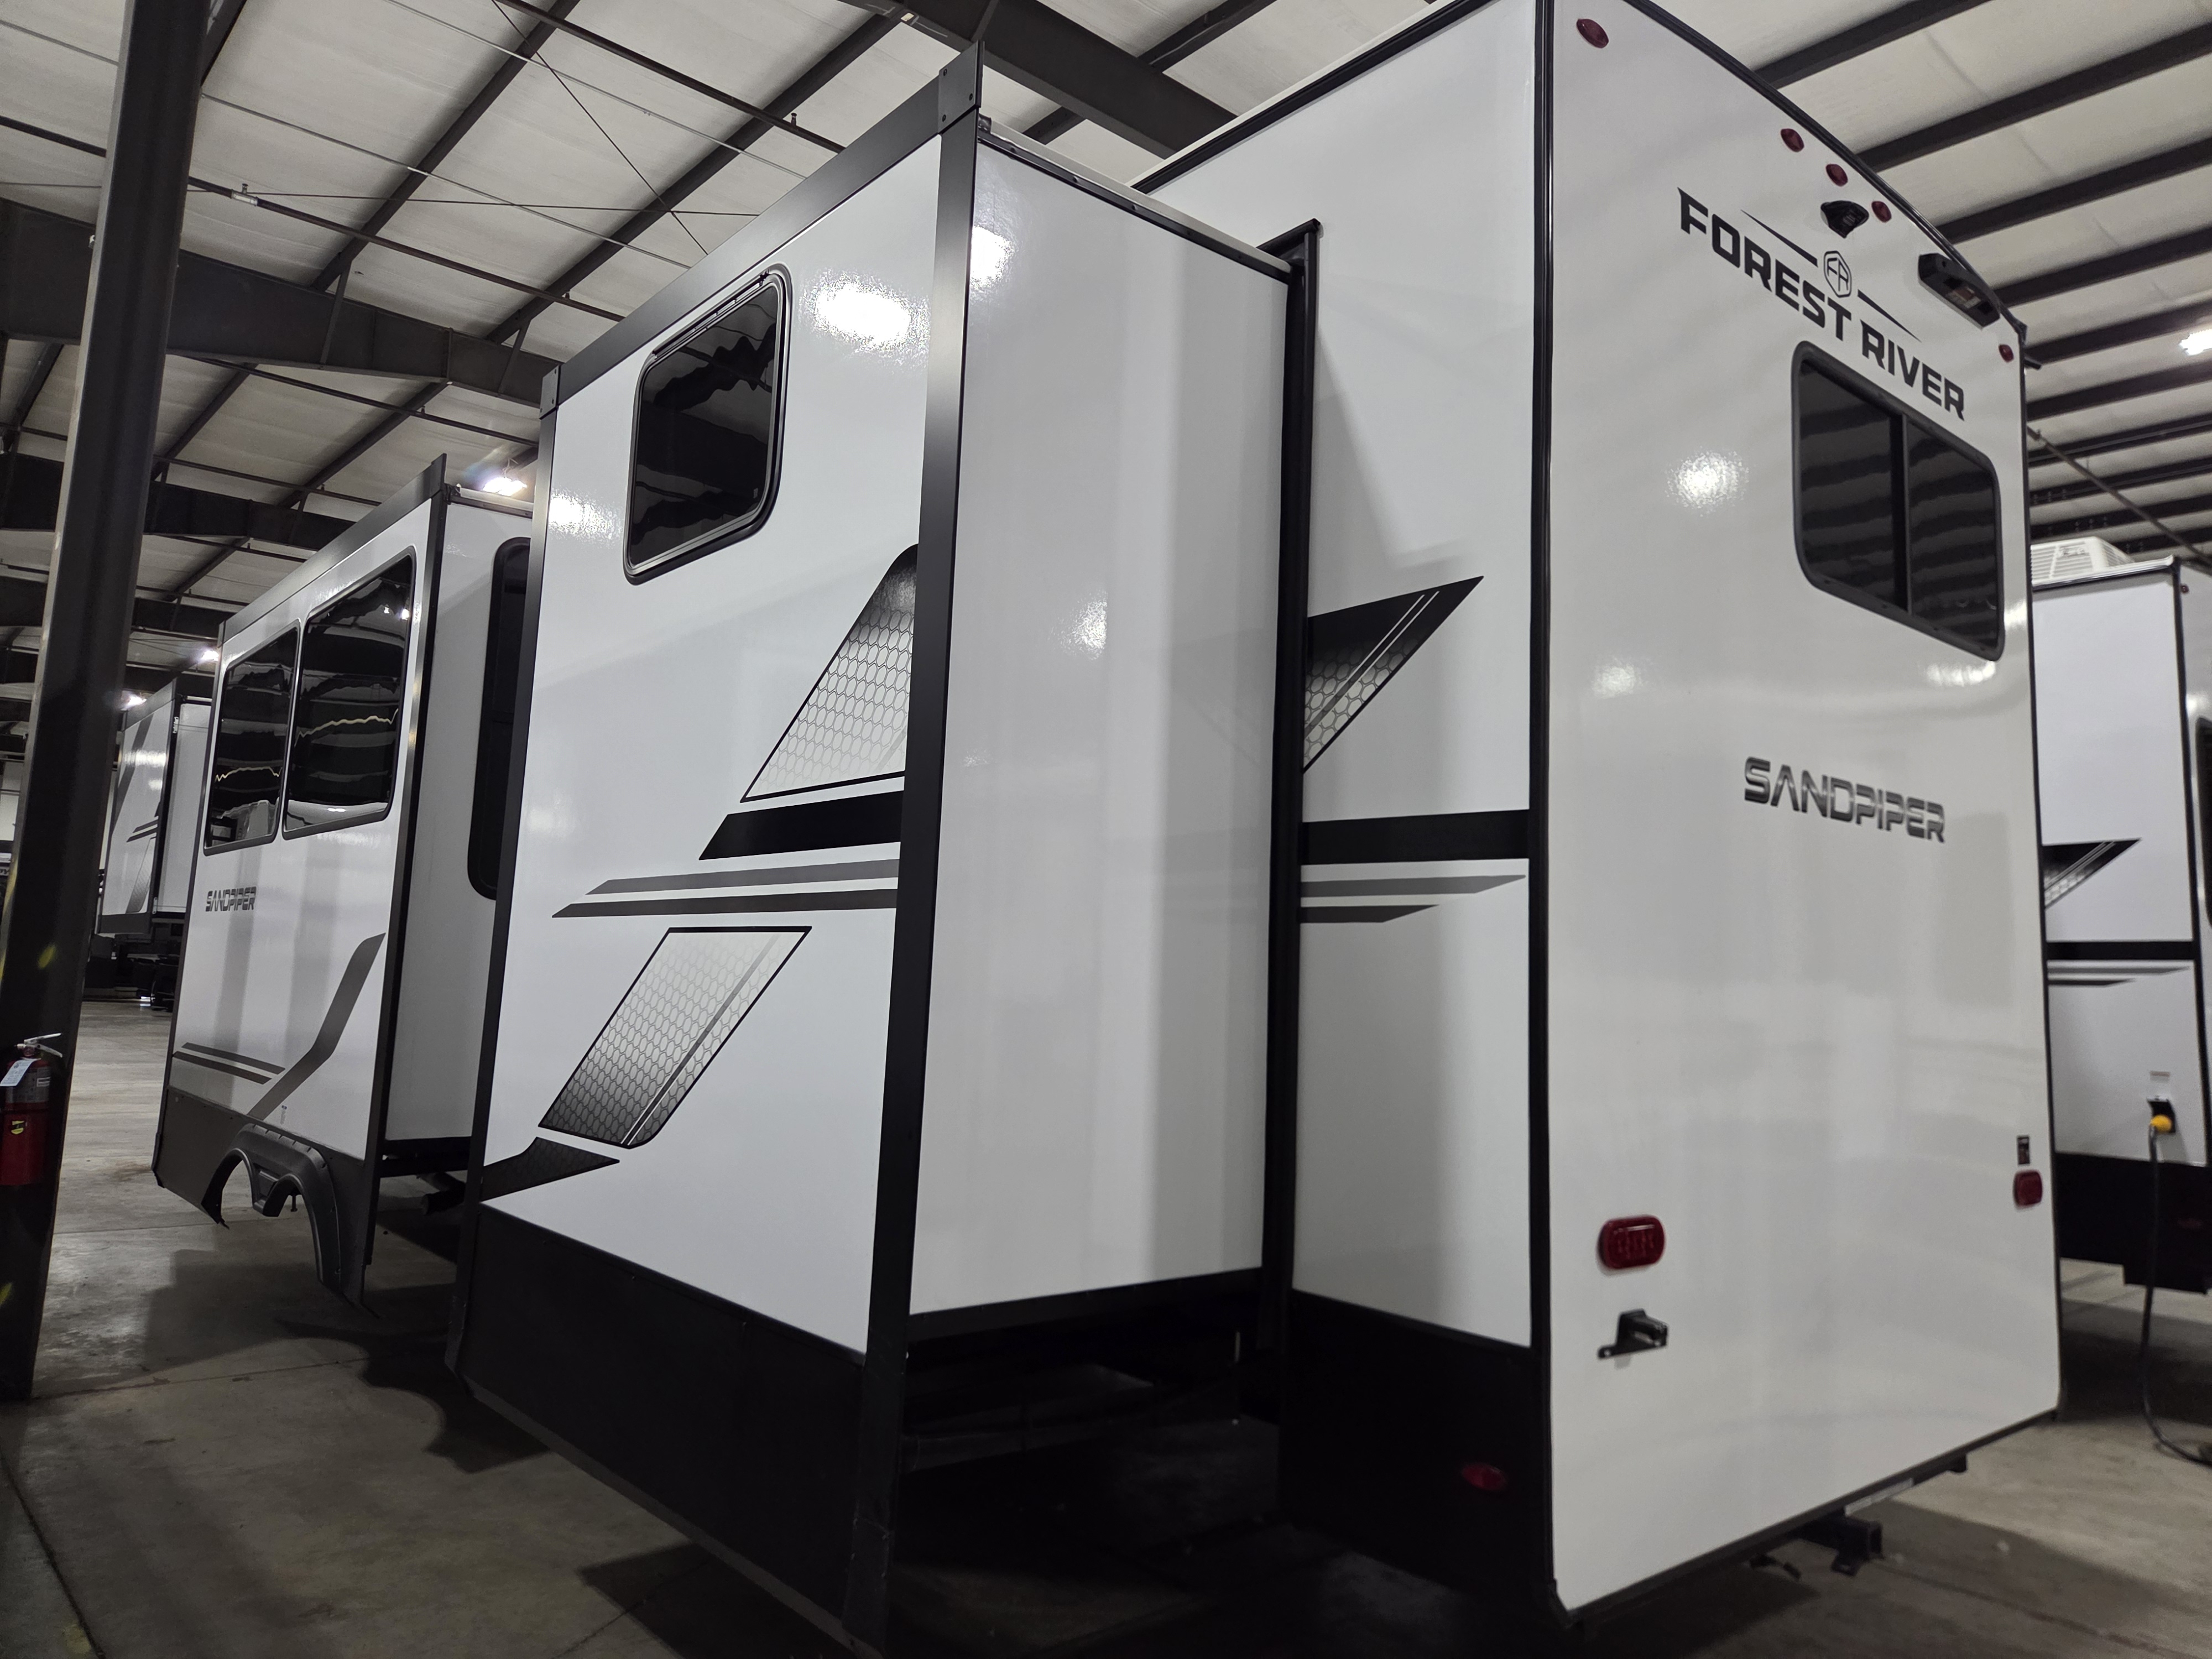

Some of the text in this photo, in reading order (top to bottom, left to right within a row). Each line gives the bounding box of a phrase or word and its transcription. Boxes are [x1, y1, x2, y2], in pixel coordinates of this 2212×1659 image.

[1677, 187, 1964, 421] FOREST RIVER
[1744, 756, 1945, 843] SANDPIPER
[205, 886, 257, 912] SANDPIPER
